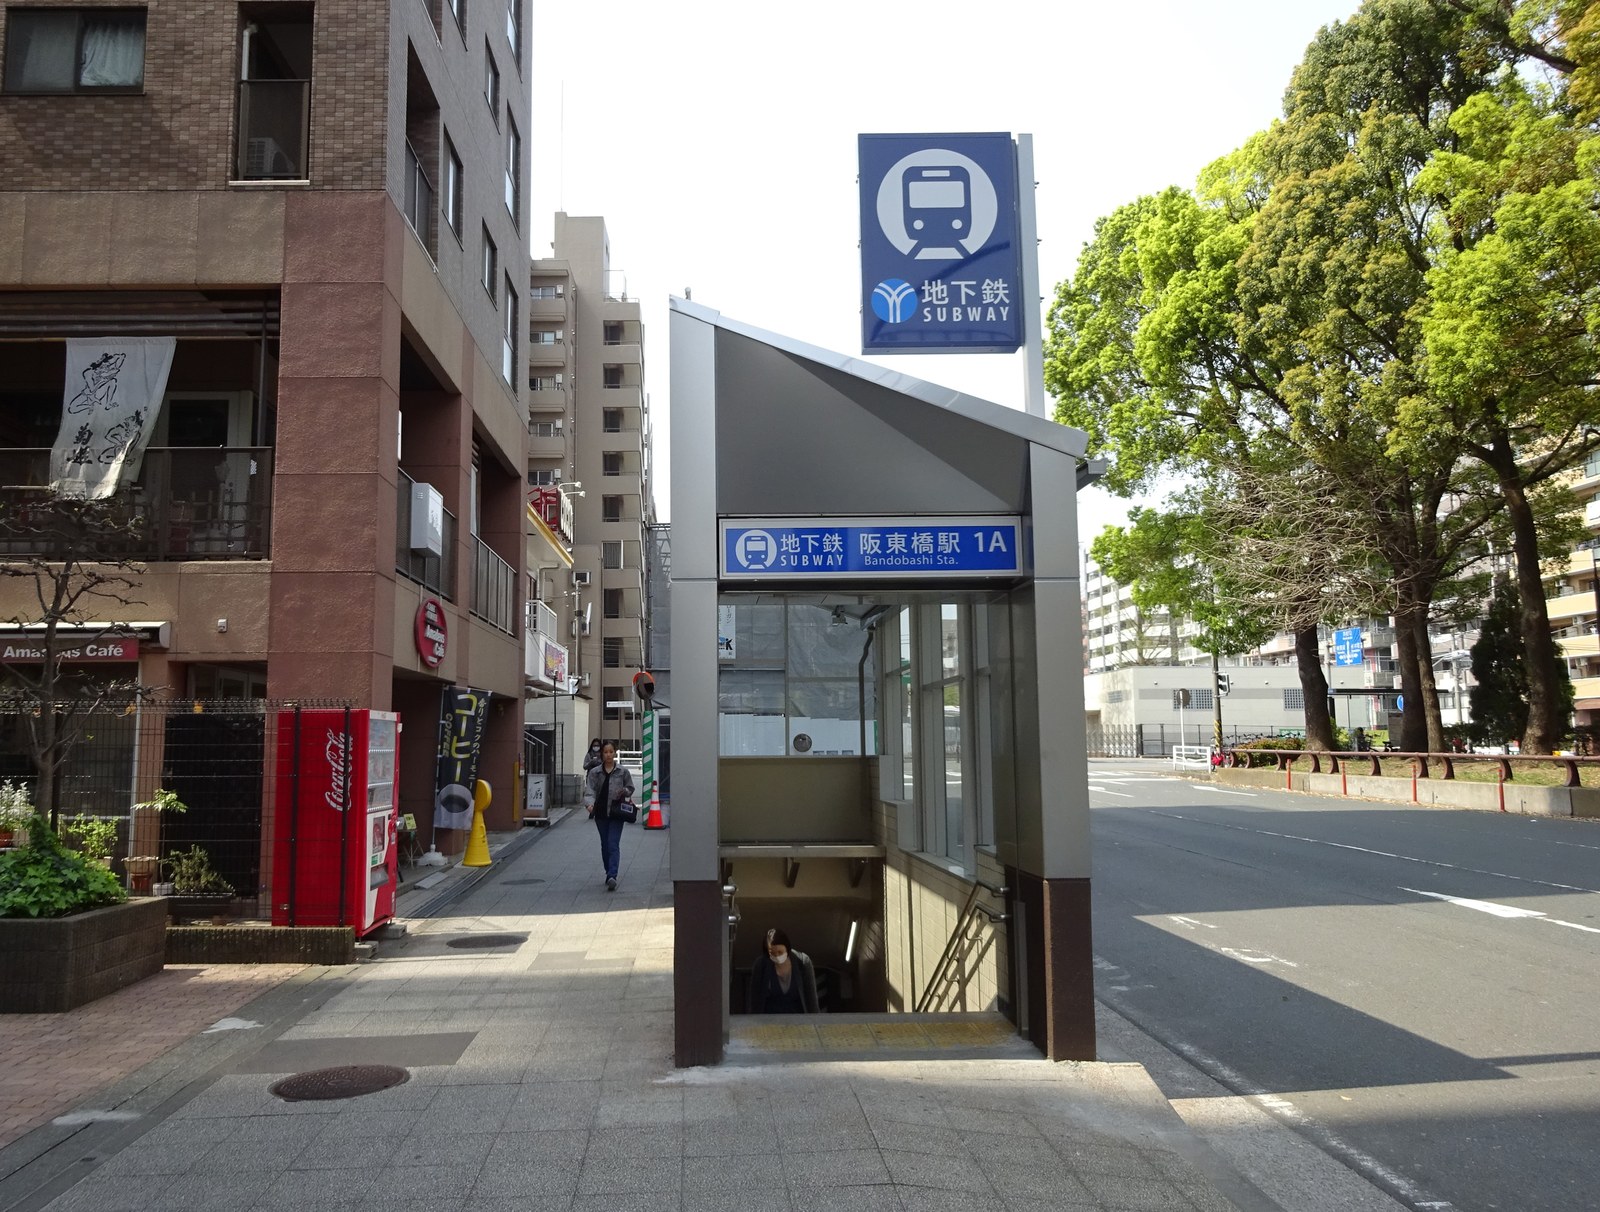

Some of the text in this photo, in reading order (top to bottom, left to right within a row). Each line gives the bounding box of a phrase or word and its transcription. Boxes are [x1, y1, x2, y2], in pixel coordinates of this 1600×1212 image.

[921, 279, 1010, 305] 地下鉄
[923, 307, 1010, 322] SUBWAY
[780, 533, 843, 553] 地下鉄
[859, 531, 1007, 554] 阪東橋駅 1A
[780, 554, 844, 566] SUBWAY
[864, 554, 959, 566] Bandobashi Sta.
[3, 644, 124, 658] Amaus Café
[442, 713, 453, 758] COFFEE
[451, 693, 478, 783] コーヒー
